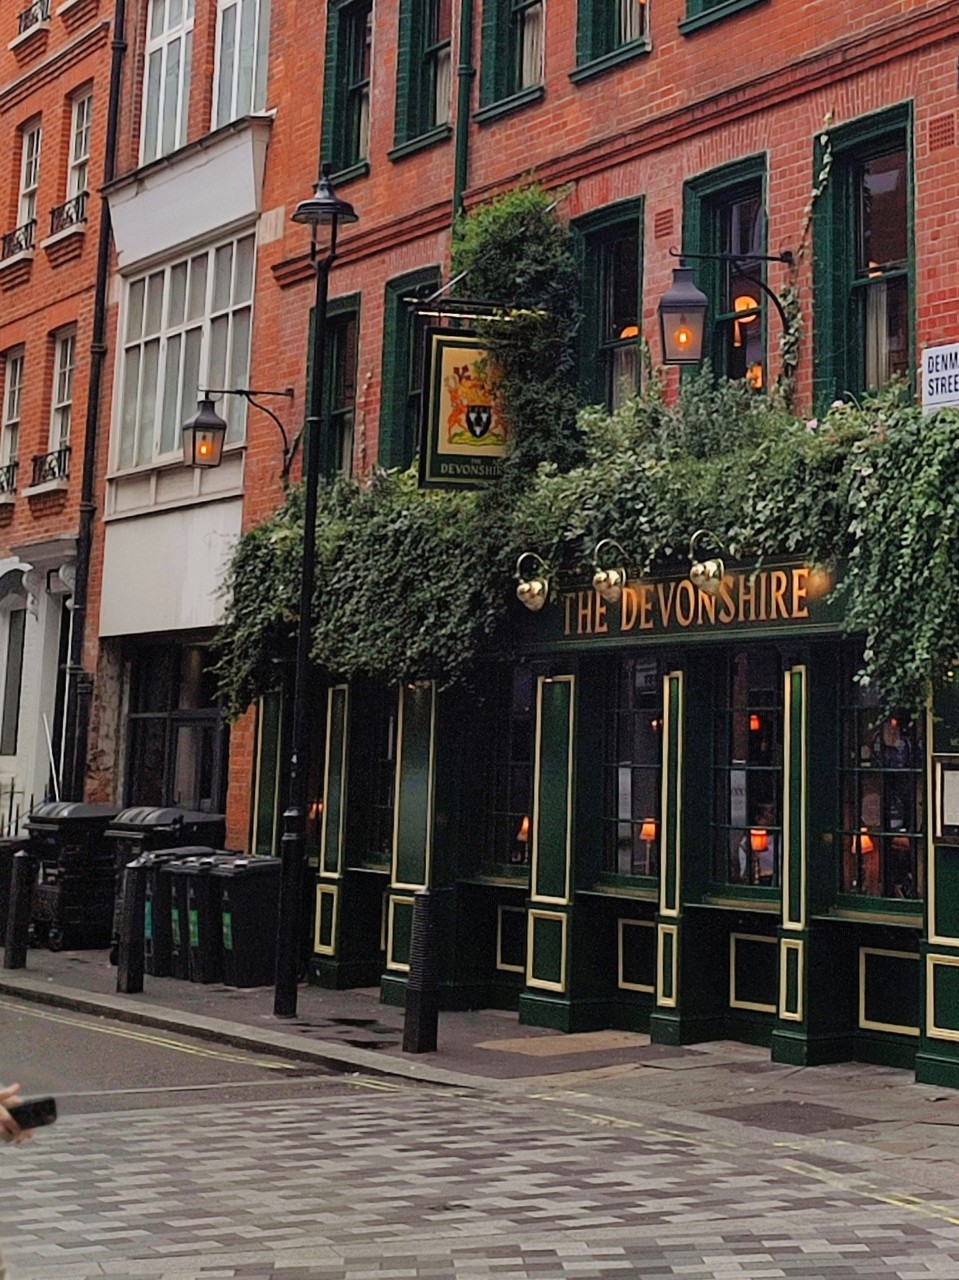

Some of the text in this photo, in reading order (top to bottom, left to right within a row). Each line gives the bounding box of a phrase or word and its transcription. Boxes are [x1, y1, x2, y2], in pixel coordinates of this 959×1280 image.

[440, 462, 503, 477] DEVONSHIR
[563, 568, 810, 636] THE DEVONSHIRE
